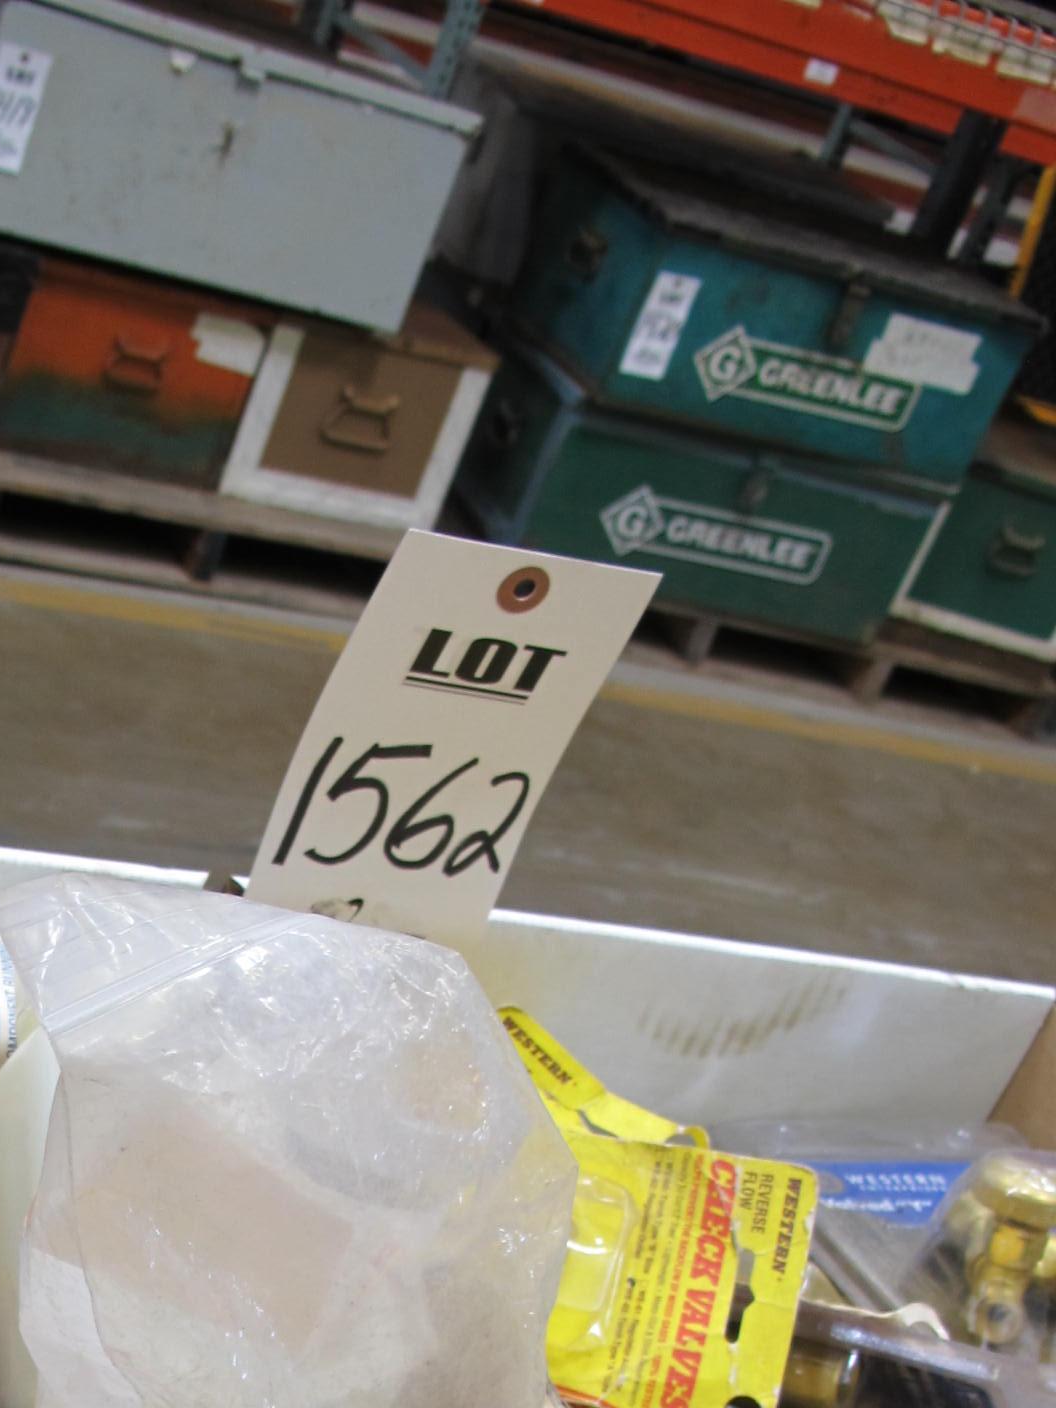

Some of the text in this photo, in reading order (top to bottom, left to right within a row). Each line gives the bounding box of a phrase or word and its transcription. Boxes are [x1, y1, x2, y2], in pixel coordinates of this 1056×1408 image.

[758, 358, 907, 414] GREENLEE
[667, 516, 813, 567] GREENLEE
[410, 628, 568, 692] LOT
[272, 736, 530, 877] 1562
[503, 1016, 572, 1084] WESTERN
[740, 1171, 758, 1211] FLOW
[752, 1173, 774, 1234] REVERSE
[690, 1160, 737, 1287] CHECK
[772, 1177, 802, 1274] WESTERN
